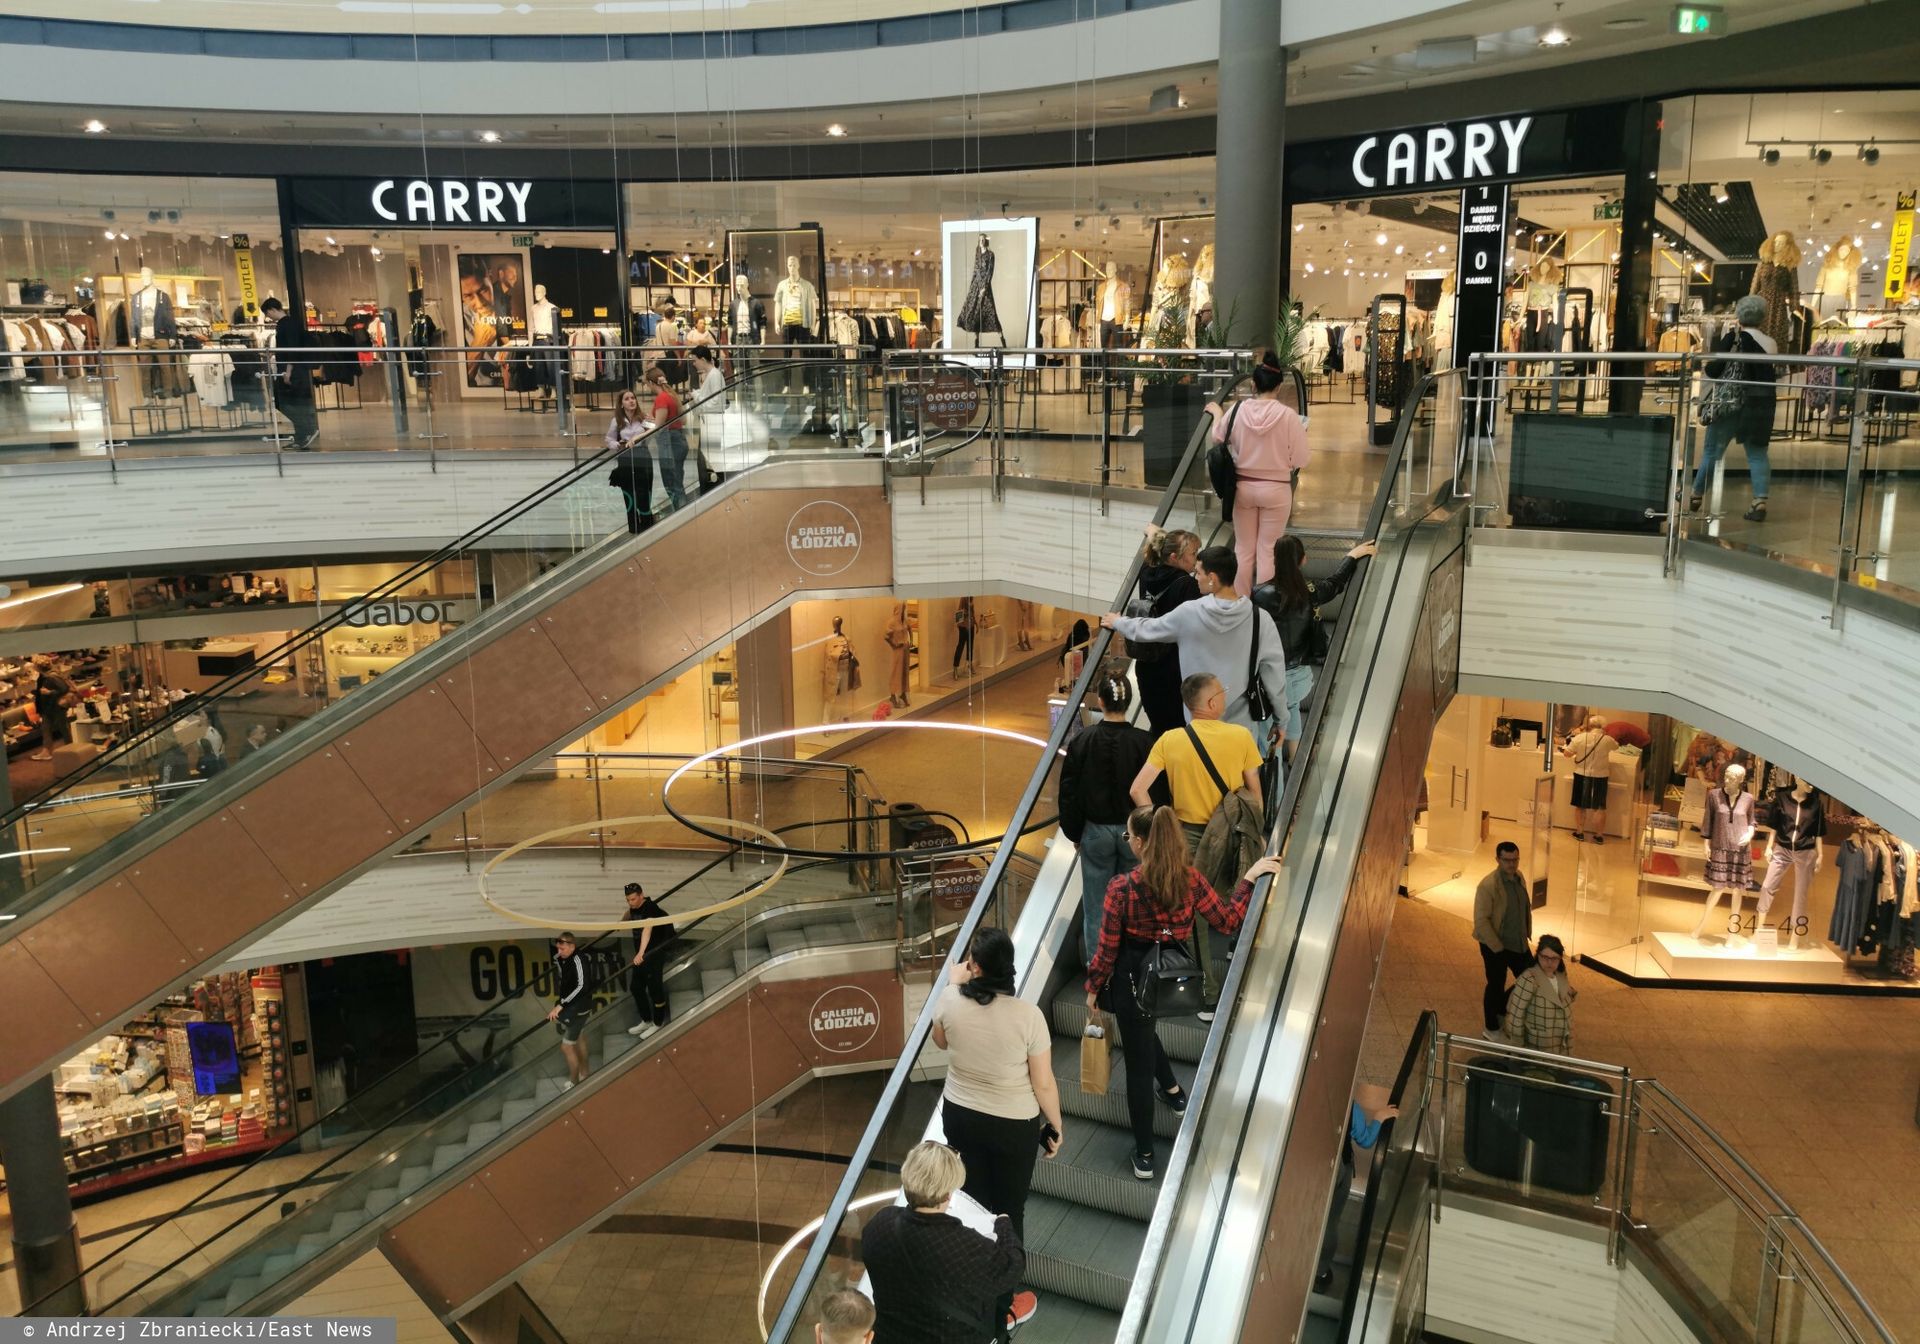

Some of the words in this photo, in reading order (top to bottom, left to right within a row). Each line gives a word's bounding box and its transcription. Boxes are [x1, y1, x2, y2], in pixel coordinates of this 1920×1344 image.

[1352, 117, 1533, 188] CARRY
[371, 180, 533, 223] CARRY
[1470, 205, 1498, 215] DAMSKI
[1464, 224, 1501, 234] DZIECIĘCY
[1472, 215, 1495, 225] MĘSKI
[1891, 219, 1909, 275] OUTLET
[1474, 251, 1488, 270] 0
[240, 256, 254, 299] OUTLET
[1465, 276, 1493, 285] DAMSKI
[798, 526, 845, 536] GALERIA
[791, 532, 857, 550] ŁÓDZKA
[340, 595, 460, 628] Gabor
[470, 945, 526, 1001] GO
[813, 1012, 876, 1031] ŁÓDZKA
[821, 1007, 865, 1019] GALERIA
